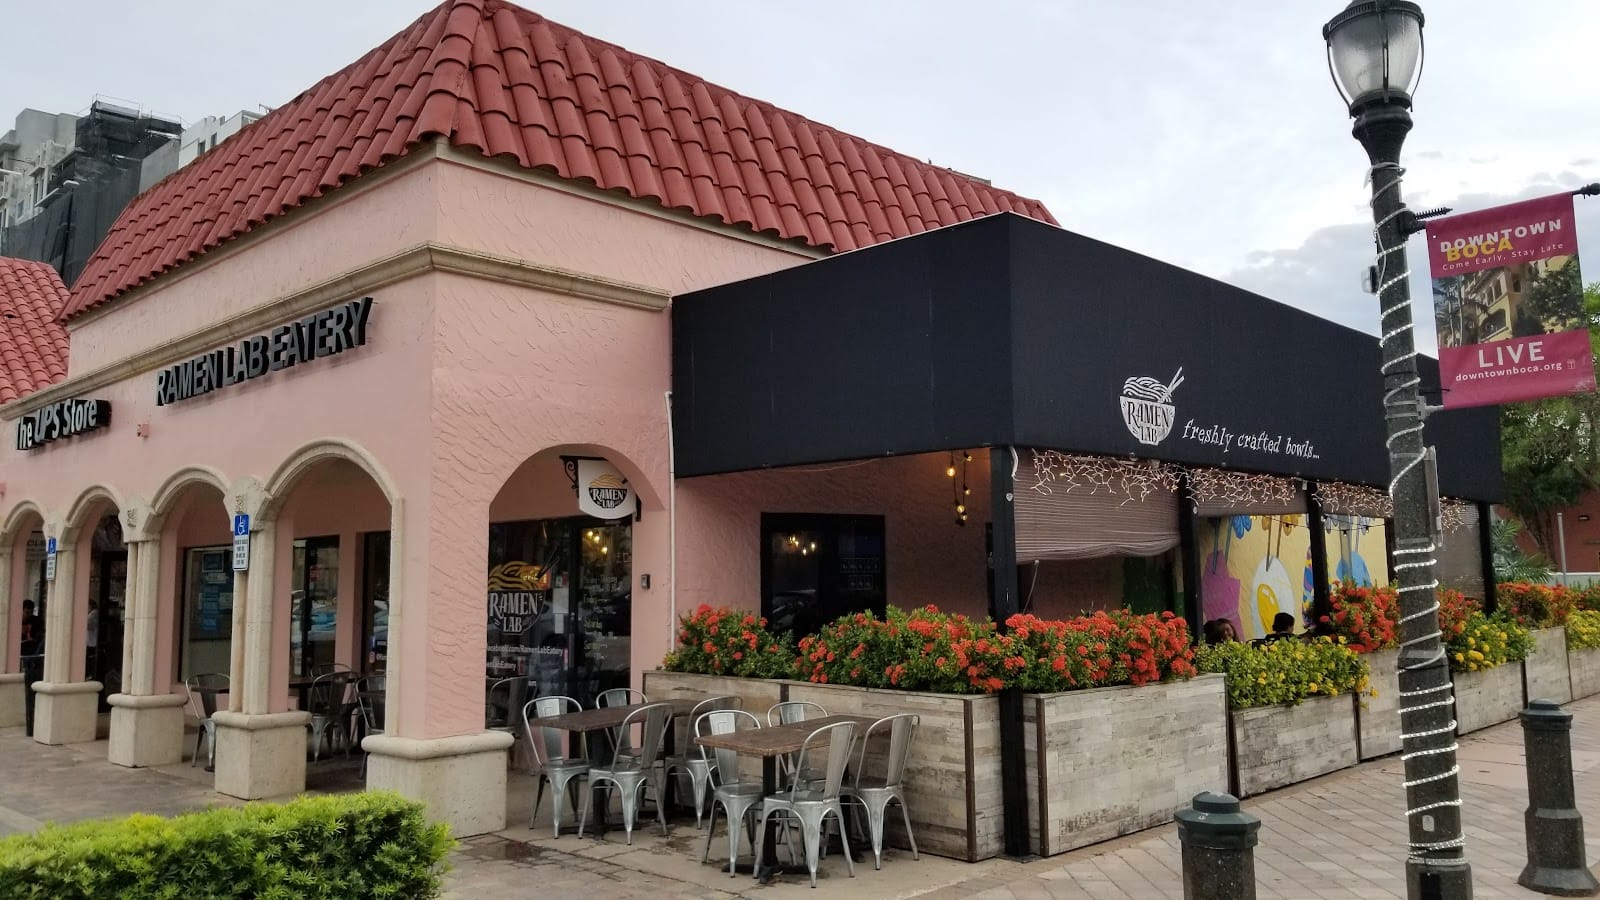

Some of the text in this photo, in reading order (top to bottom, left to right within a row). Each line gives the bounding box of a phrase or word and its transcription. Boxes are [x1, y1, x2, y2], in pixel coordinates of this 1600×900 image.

[1440, 219, 1561, 253] DOWNTOWN
[1446, 237, 1514, 262] BOCA
[1442, 242, 1564, 271] Come Early, Stay Late
[156, 297, 373, 405] RAMEN LAB EATERY
[1478, 341, 1545, 368] LIVE
[1455, 361, 1562, 382] downtownboca.org
[34, 402, 60, 443] UPS
[62, 398, 97, 436] Store
[1127, 401, 1170, 429] RAMEN
[1140, 426, 1158, 442] LAB
[1182, 419, 1320, 459] freshly crafted bowls...
[592, 488, 624, 501] RAMEN
[602, 500, 615, 508] LAB
[489, 592, 539, 619] RAMEN
[503, 616, 522, 633] LAB
